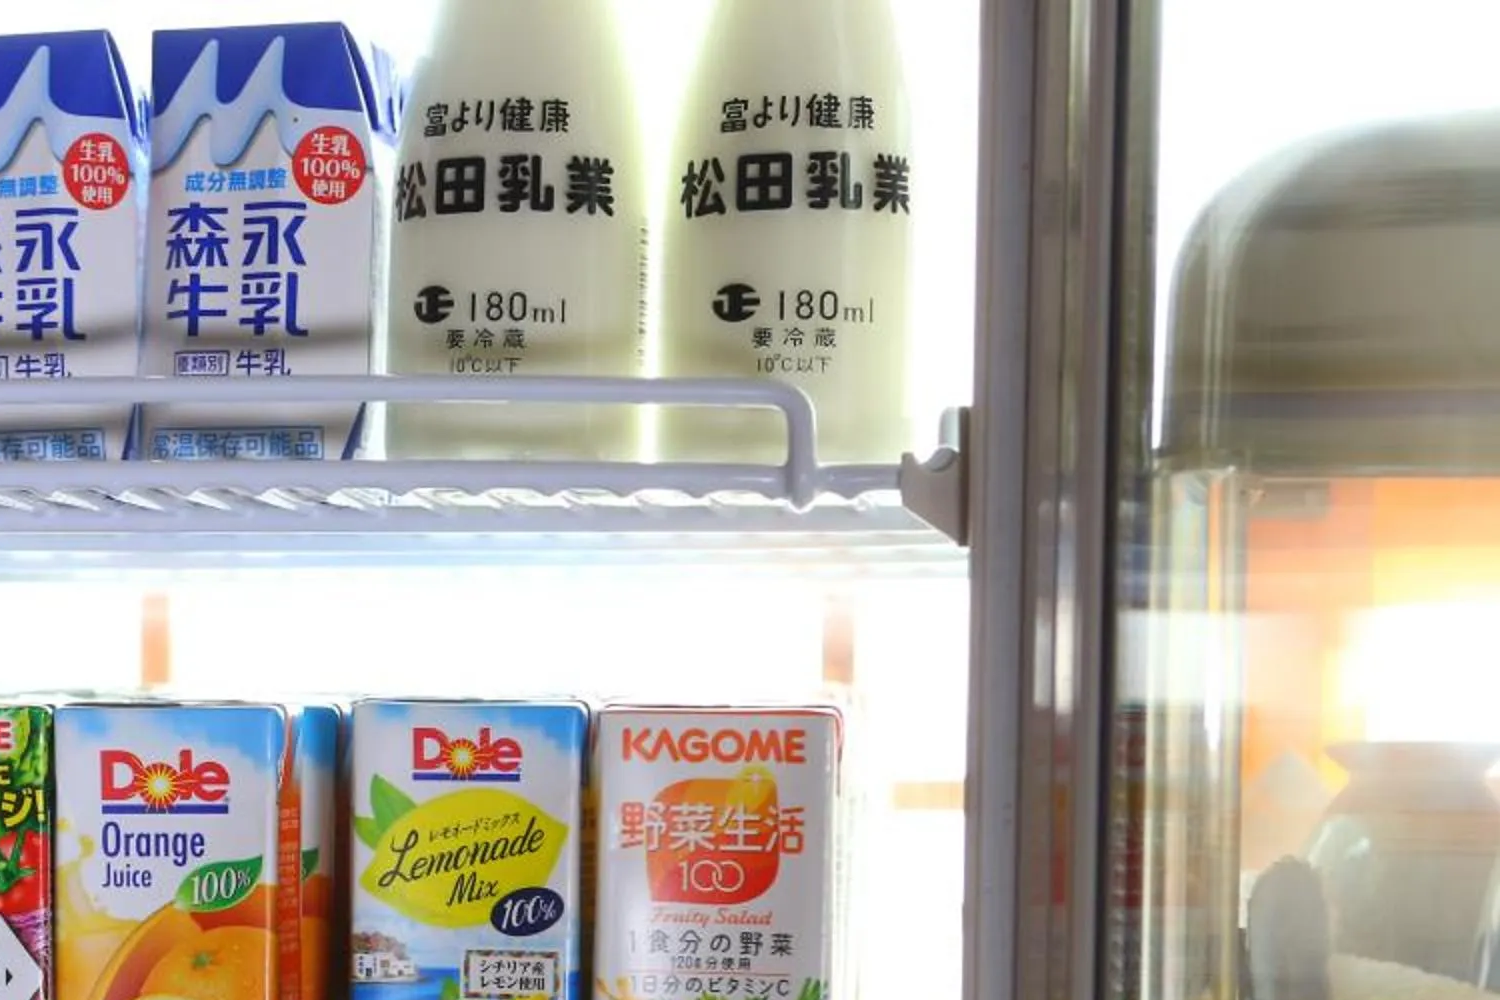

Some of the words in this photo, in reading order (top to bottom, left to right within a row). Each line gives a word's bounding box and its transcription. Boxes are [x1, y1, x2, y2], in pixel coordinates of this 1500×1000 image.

[425, 97, 570, 137] 富より健康
[721, 93, 875, 133] 富より健康
[80, 141, 116, 163] 生乳
[311, 133, 351, 157] 生乳
[70, 164, 125, 184] 100%
[185, 171, 287, 193] 成分無調整
[300, 157, 360, 179] 100%
[81, 185, 113, 205] 使用
[311, 180, 346, 199] 使用
[395, 154, 614, 222] 松田乳業
[682, 152, 910, 218] 松田乳業
[166, 201, 307, 270] 森永
[167, 271, 308, 337] 牛乳
[468, 291, 566, 323] 180ml
[777, 290, 874, 323] 180ml
[447, 329, 527, 349] 要冷蔵
[751, 328, 837, 349] 要冷蔵
[15, 353, 71, 379] 牛乳
[236, 348, 291, 377] 牛乳
[151, 430, 320, 460] 常温保存可能品
[412, 727, 523, 773] Dole
[622, 728, 806, 763] KAGOME
[100, 749, 230, 804] Dole
[621, 802, 804, 855] 野菜生活
[101, 822, 206, 868] Orange
[378, 816, 545, 887] Lemonade
[101, 863, 152, 888] Juice
[192, 870, 252, 908] 100%
[446, 872, 499, 906] Mix
[679, 859, 745, 892] 100
[502, 895, 556, 930] 100%
[652, 907, 709, 927] Fruity
[715, 909, 773, 926] Salad
[629, 929, 794, 956] 1食分の野菜
[480, 960, 545, 973] シチリア産
[480, 977, 545, 991] レモン使用
[631, 975, 790, 996] 1日分のビタミンC
